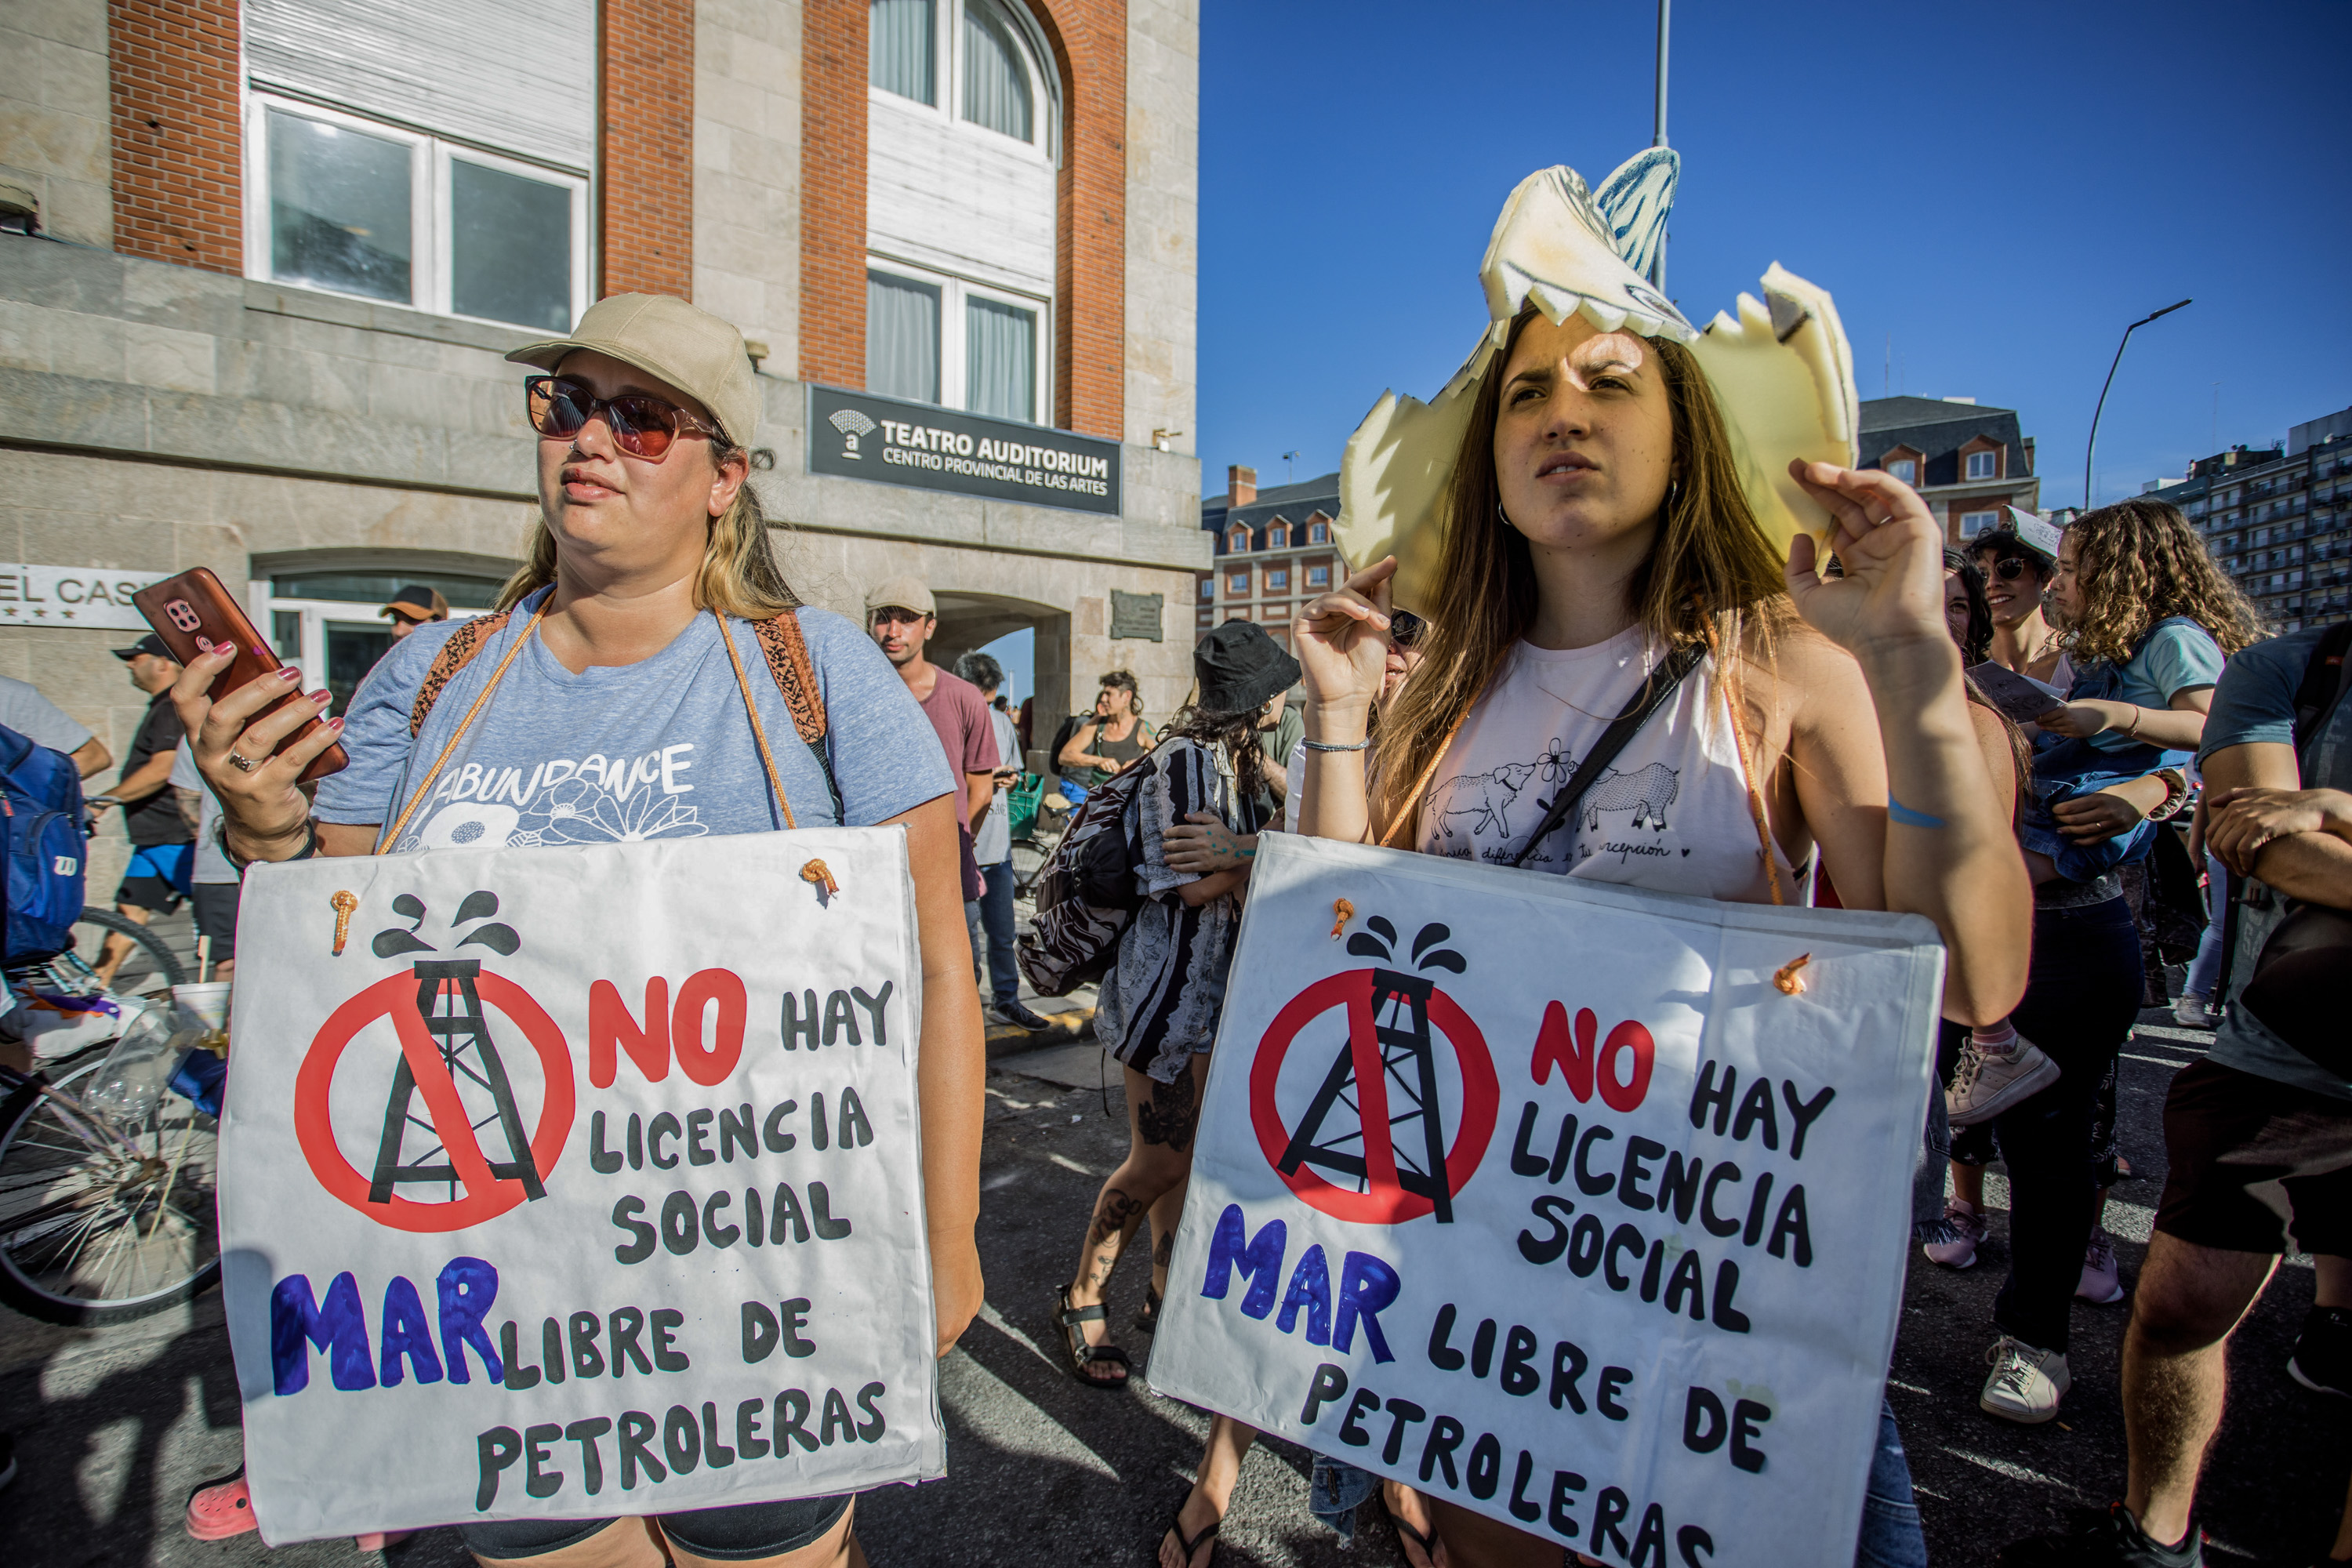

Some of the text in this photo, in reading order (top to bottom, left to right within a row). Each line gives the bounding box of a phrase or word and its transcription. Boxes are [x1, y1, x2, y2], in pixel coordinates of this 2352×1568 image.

[880, 419, 1109, 480] TEATRO AUDITORIUM
[882, 447, 1109, 496] CENTRO PROVINCIAL DE LAS ARTES
[56, 579, 148, 607] CAS
[409, 742, 695, 834] ABUNDANCE
[1599, 838, 1671, 865] rcepción
[589, 967, 893, 1089] NO HAY
[1530, 1000, 1836, 1160] NO HAY
[590, 1087, 874, 1174] LICENCIA
[612, 1181, 852, 1265] SOCIAL
[1510, 1101, 1813, 1268] LICENCIA
[1516, 1195, 1751, 1334] SOCIAL
[270, 1256, 816, 1396] MAR LIBRE DE
[1200, 1203, 1772, 1473] MAR LIBRE DE
[476, 1382, 887, 1512] PETROLERAS
